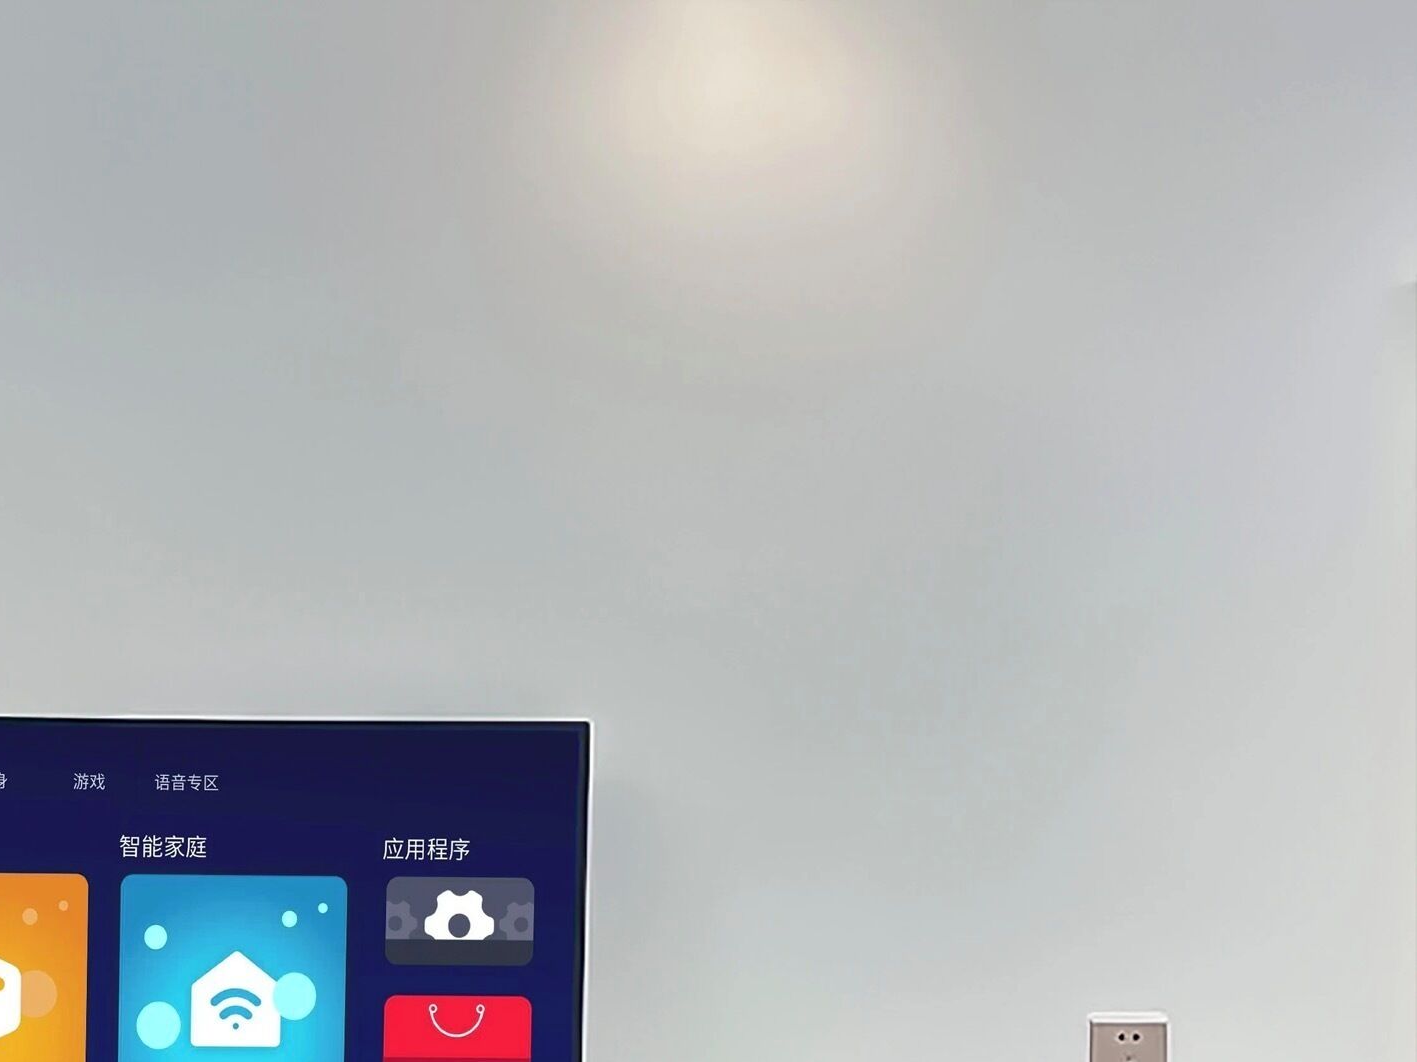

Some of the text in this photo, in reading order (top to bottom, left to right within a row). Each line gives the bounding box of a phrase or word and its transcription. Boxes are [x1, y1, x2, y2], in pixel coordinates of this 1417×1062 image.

[72, 772, 106, 791] 游戏
[154, 773, 220, 792] 语音专区
[118, 834, 208, 859] 智能家庭
[382, 837, 471, 861] 应用程序
